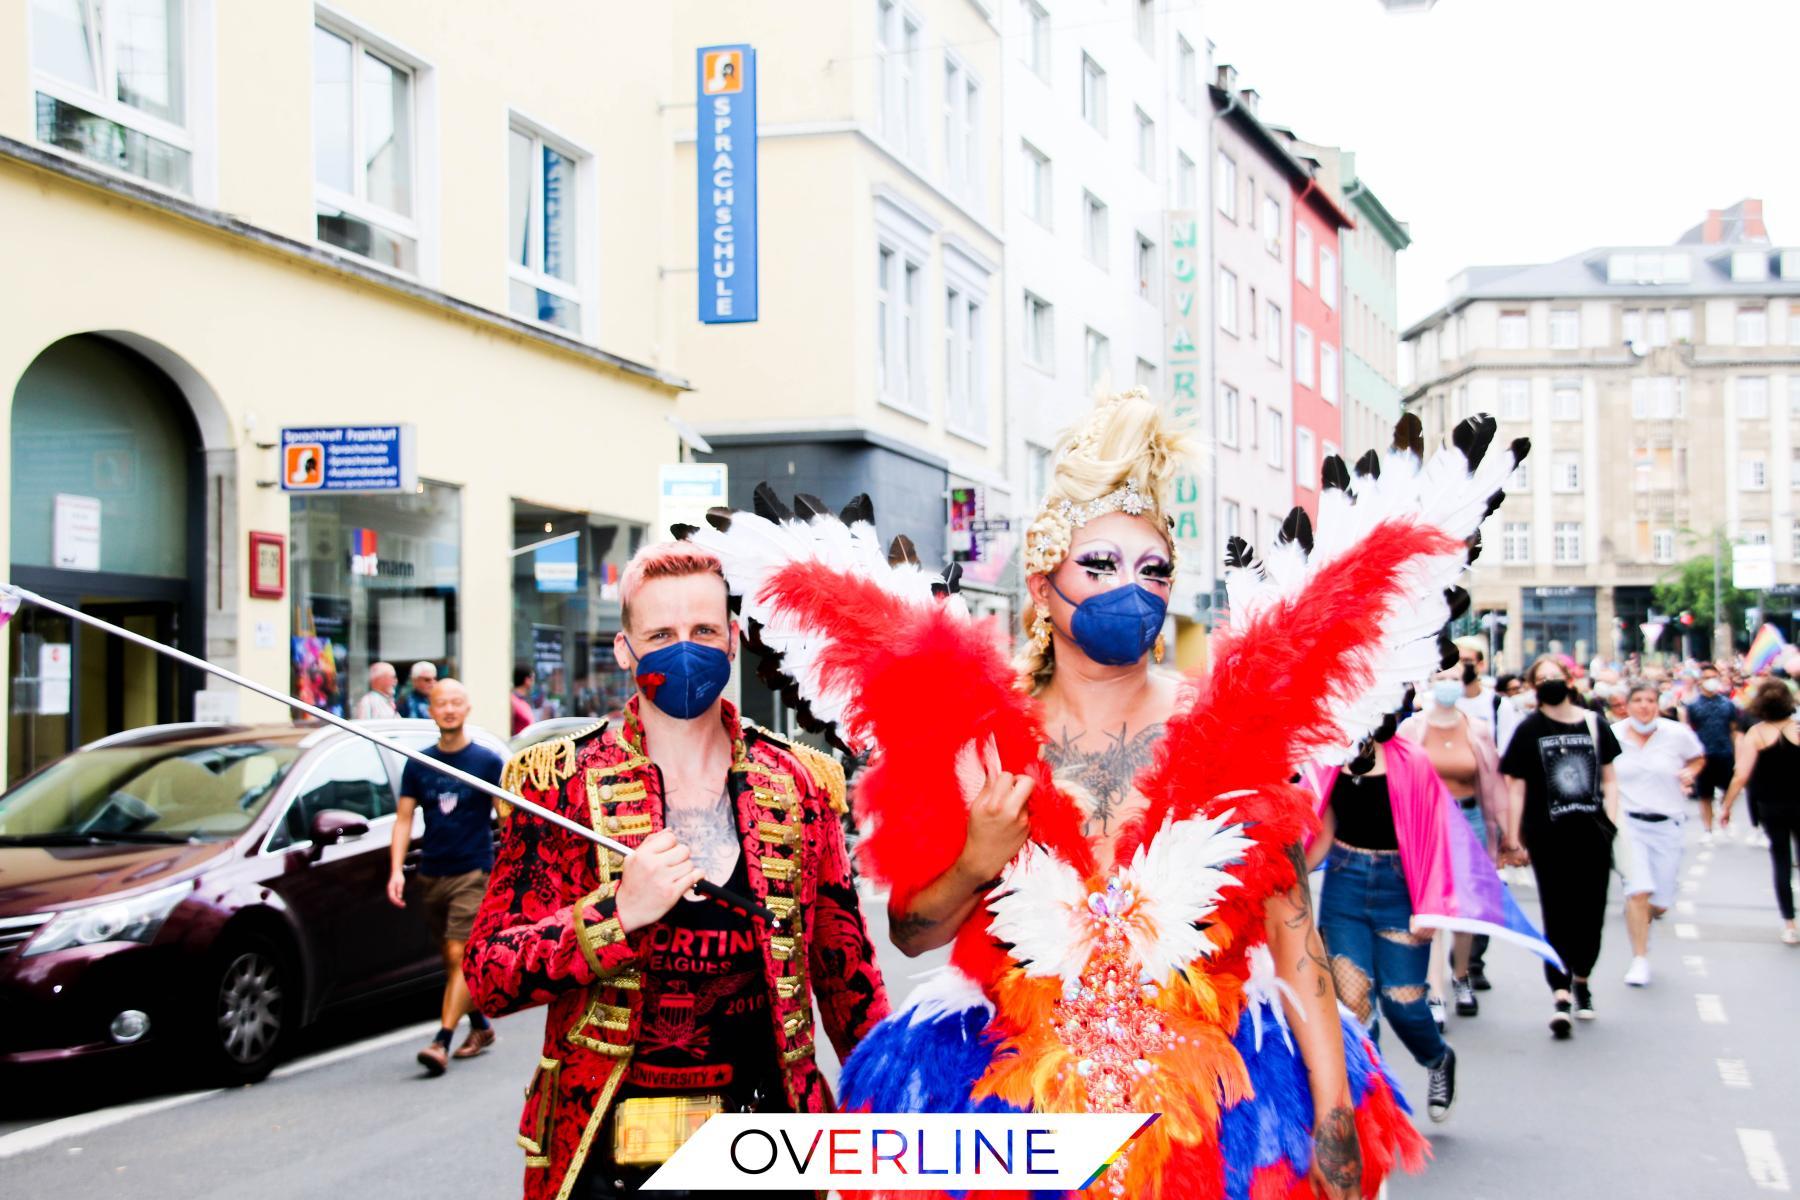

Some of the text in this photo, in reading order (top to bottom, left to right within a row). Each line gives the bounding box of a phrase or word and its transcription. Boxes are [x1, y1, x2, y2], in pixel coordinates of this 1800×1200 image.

[713, 96, 734, 316] SPRACHSCHULE
[1171, 220, 1198, 353] NOVA
[346, 428, 397, 441] Frankfurt
